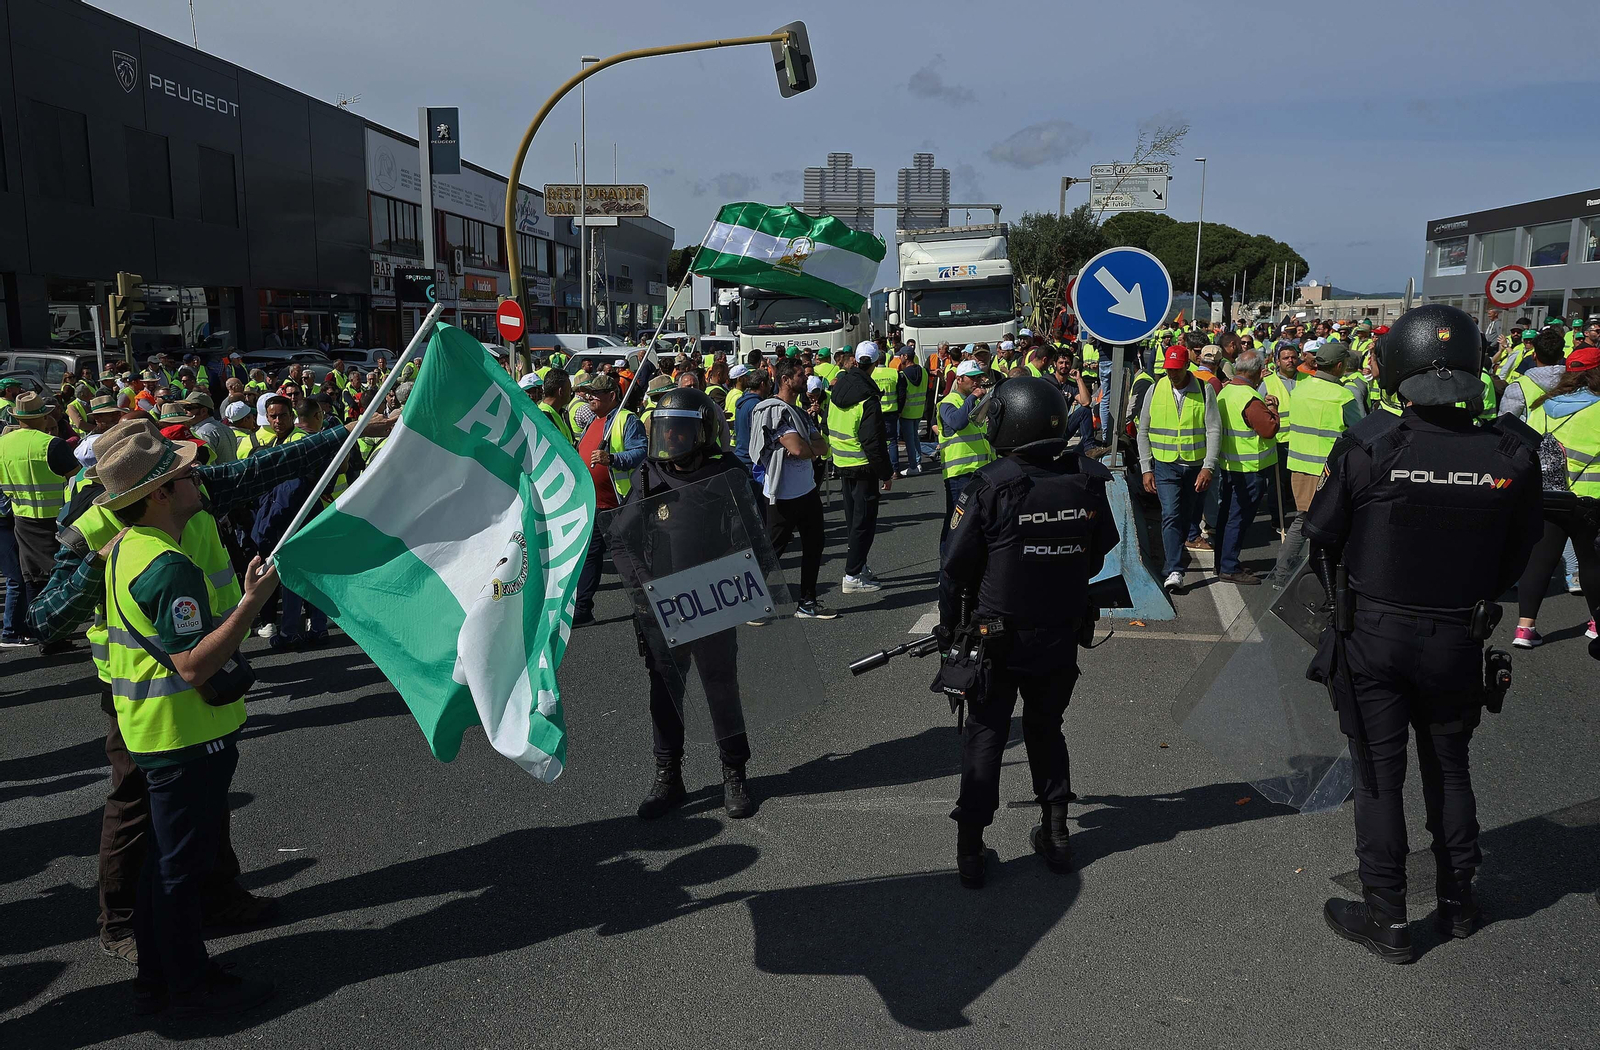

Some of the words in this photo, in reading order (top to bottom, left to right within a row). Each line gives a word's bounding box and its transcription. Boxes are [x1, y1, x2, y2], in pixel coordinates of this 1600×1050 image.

[149, 73, 239, 117] PEUGEOT
[547, 201, 576, 214] BAR
[374, 261, 392, 276] BAR
[951, 265, 977, 276] FSR
[404, 274, 432, 282] SPOTICAR
[1495, 279, 1522, 294] 50
[1390, 469, 1496, 486] POLICIA
[1018, 507, 1088, 526] POLICIA
[1023, 544, 1083, 555] POLICIA
[656, 570, 765, 628] POLICIA
[943, 686, 963, 695] POLICIA
